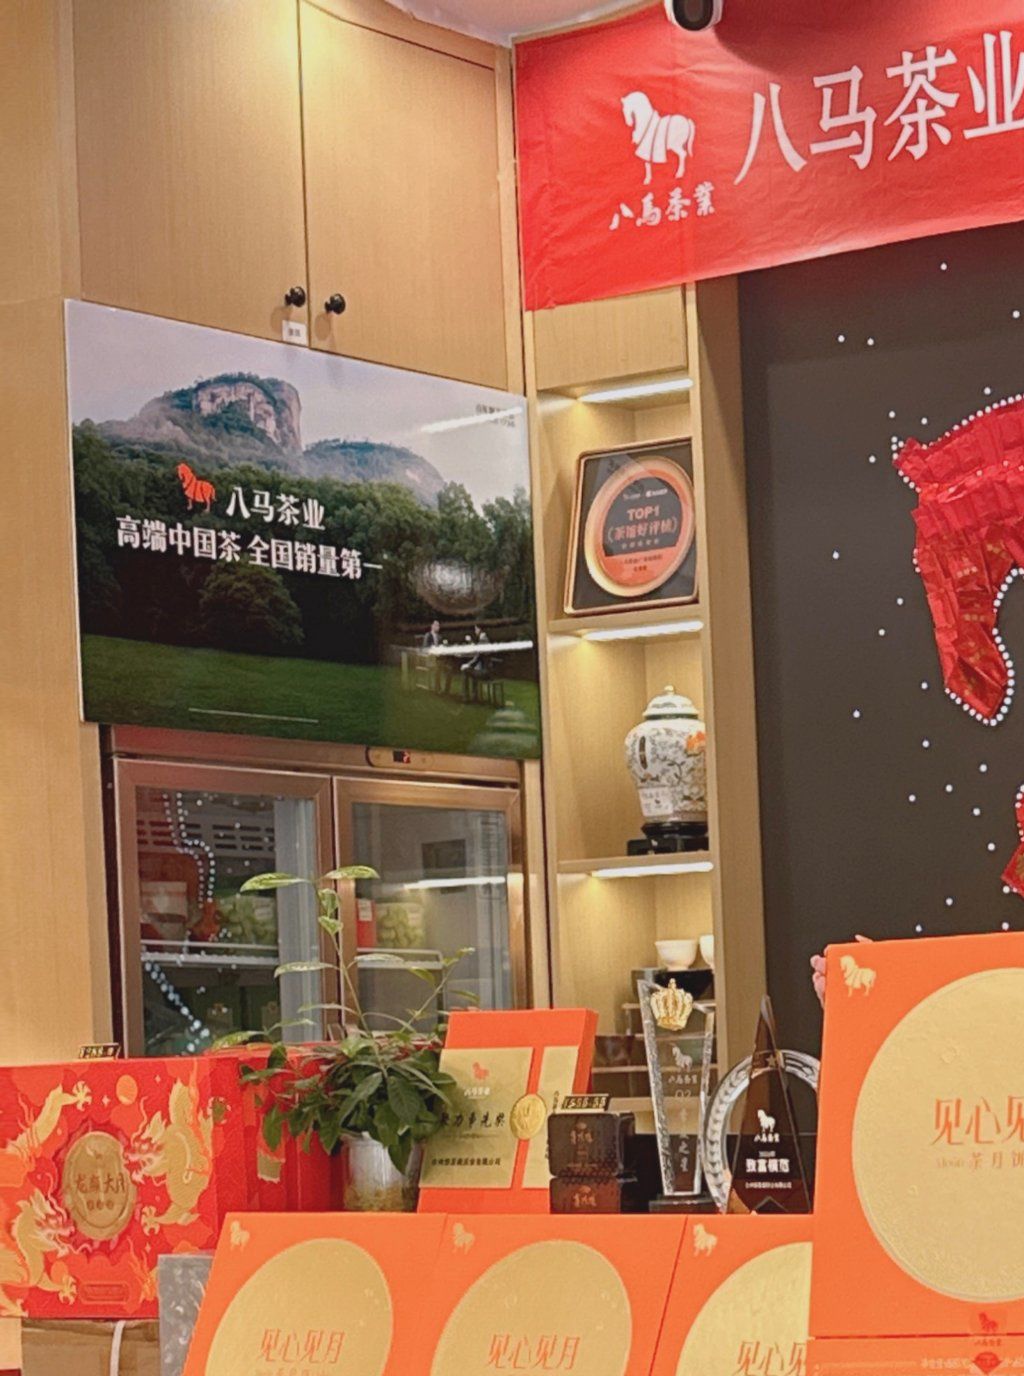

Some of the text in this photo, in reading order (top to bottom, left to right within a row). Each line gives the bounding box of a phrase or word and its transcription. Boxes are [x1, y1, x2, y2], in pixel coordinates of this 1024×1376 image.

[226, 486, 326, 531] 八马茶业
[116, 515, 383, 579] 高端中国茶 全国销量第一
[256, 1328, 345, 1364] 见心见月
[488, 1334, 581, 1370] 见心见月
